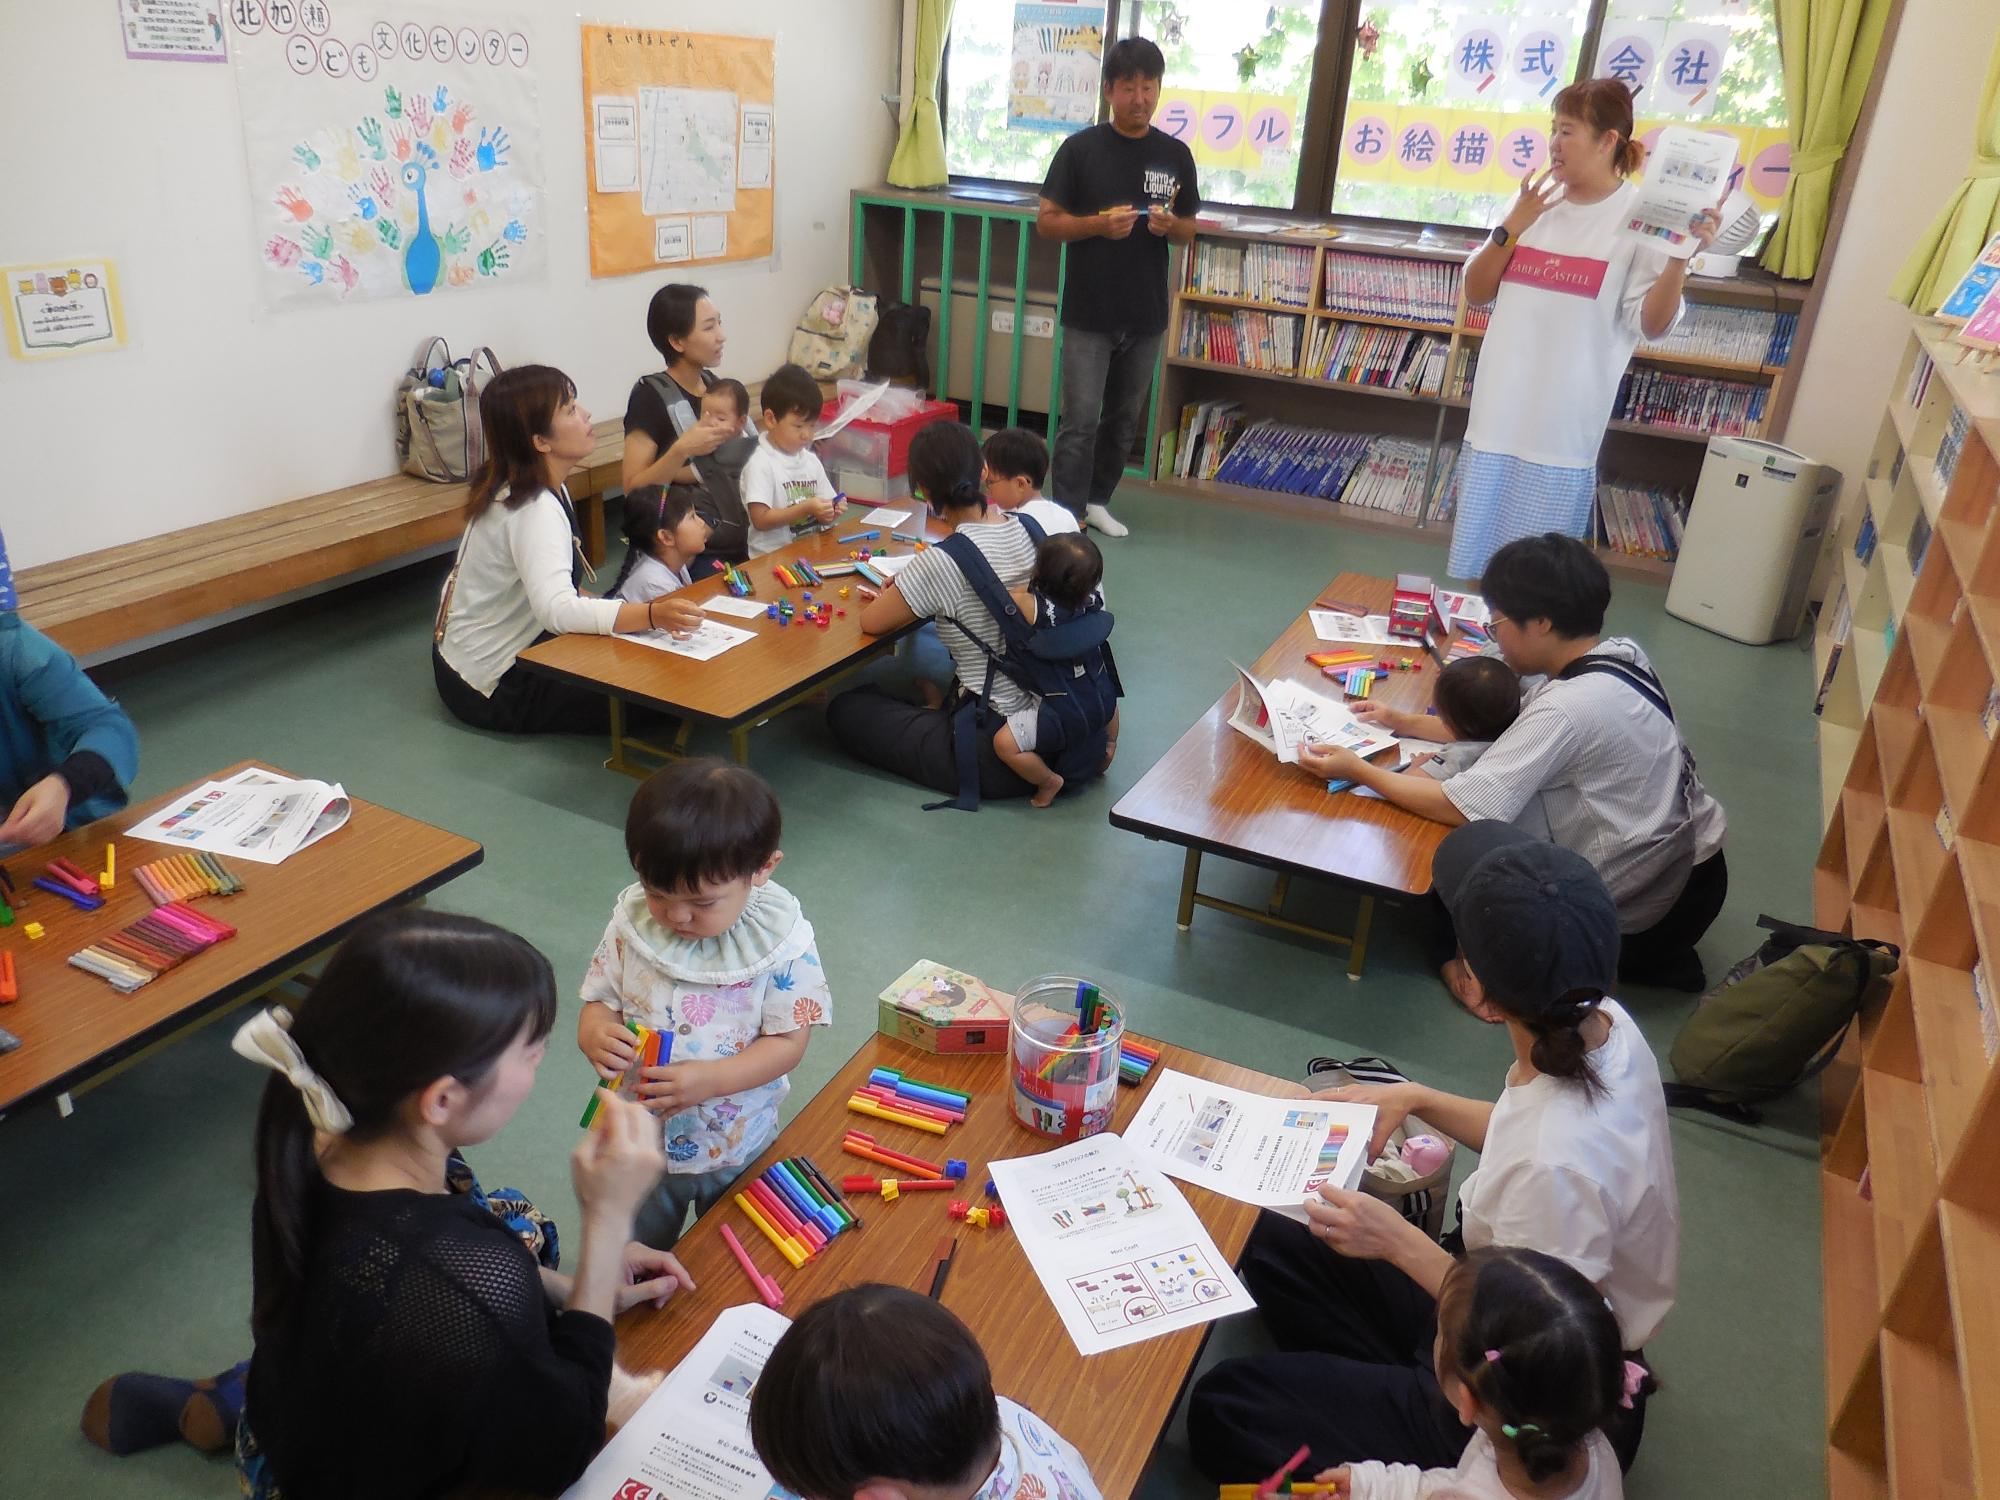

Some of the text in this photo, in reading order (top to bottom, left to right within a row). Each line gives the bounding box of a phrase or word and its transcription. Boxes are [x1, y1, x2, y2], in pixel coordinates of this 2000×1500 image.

[236, 3, 324, 29] 北加瀬
[1460, 38, 1710, 86] 株式会社
[1144, 170, 1169, 185] TOKYO
